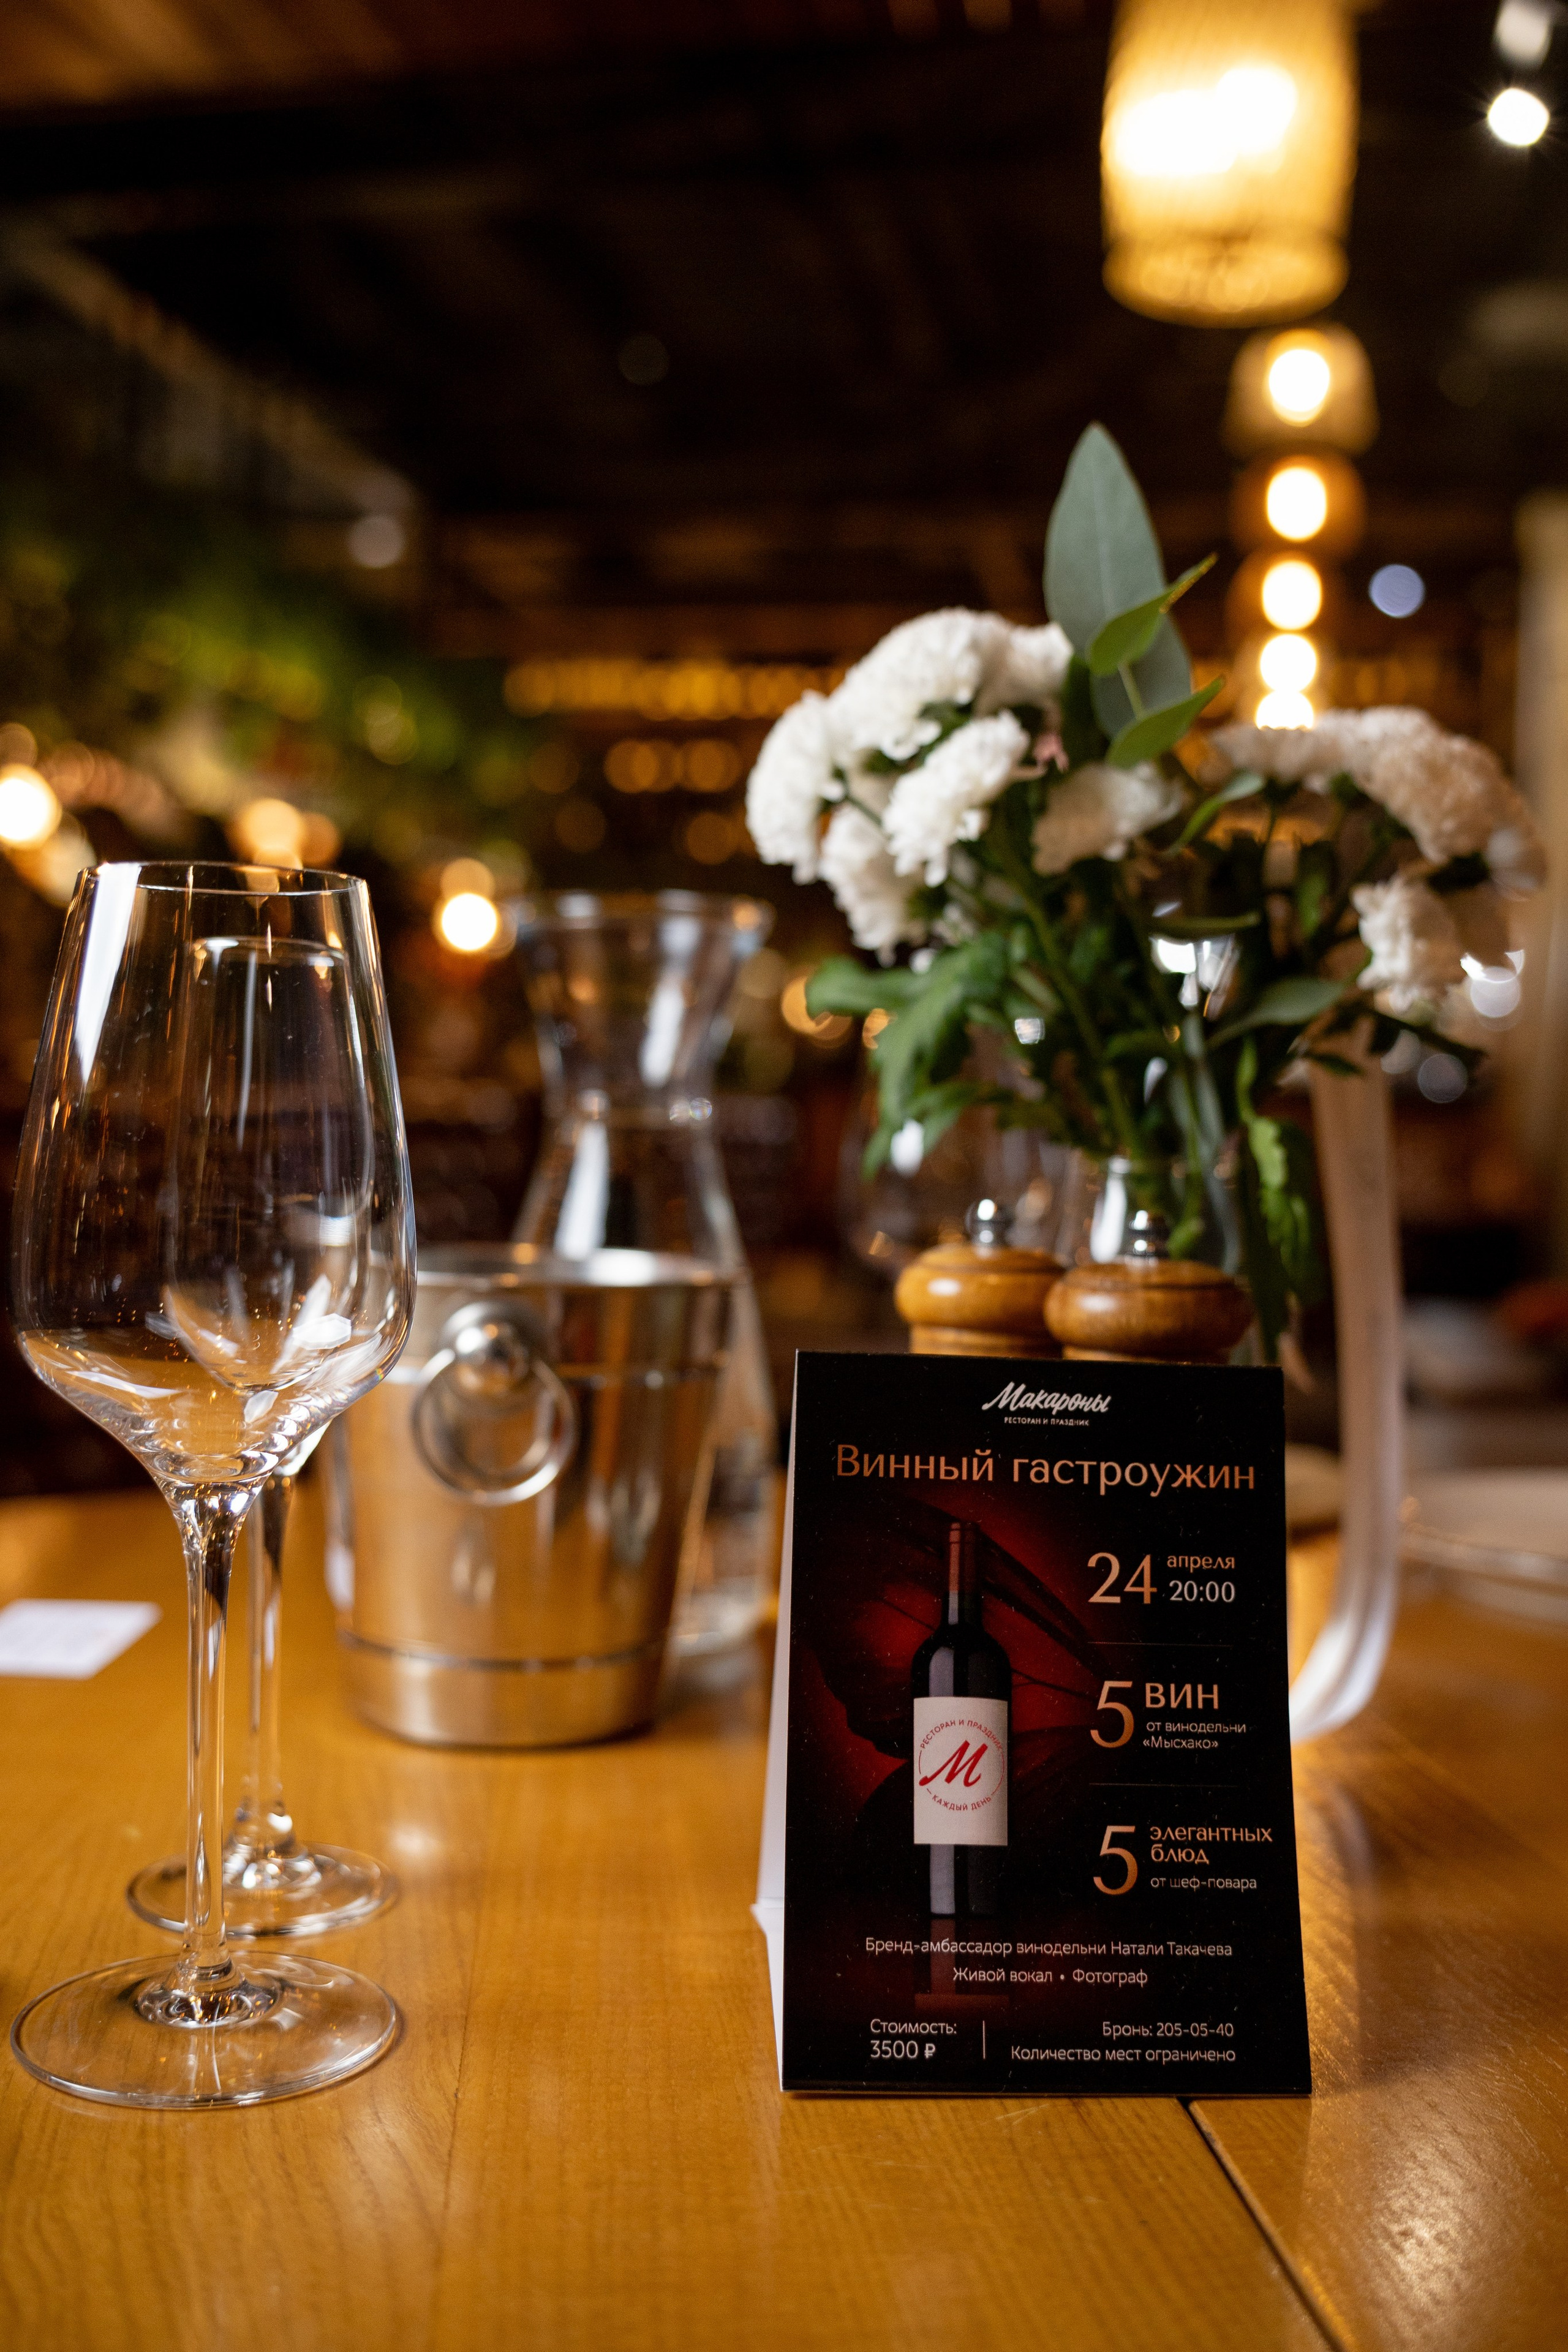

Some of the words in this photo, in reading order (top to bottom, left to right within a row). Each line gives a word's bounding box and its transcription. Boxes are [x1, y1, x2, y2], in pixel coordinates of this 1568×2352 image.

[982, 1381, 1112, 1415] Макароны
[1050, 1418, 1090, 1427] ПРАЗДНИК
[836, 1444, 994, 1482] Винный
[1013, 1457, 1255, 1497] гастроужин
[1087, 1551, 1157, 1604] 24
[1167, 1555, 1235, 1573] апреля
[1169, 1580, 1235, 1603] 20:00
[1090, 1681, 1134, 1748] 5
[921, 1721, 956, 1749] РЕСТОРАН
[967, 1721, 1003, 1750] ПРАЗДНИК
[1146, 1722, 1163, 1732] от
[1166, 1722, 1246, 1735] винодельни
[1143, 1736, 1218, 1750] «Мысхако»
[932, 1795, 968, 1811] КАЖДЫЙ
[971, 1796, 991, 1811] ДЕНЬ
[1093, 1825, 1138, 1896] 5
[1150, 1826, 1272, 1843] элегантных
[1151, 1844, 1209, 1865] блюд
[1150, 1877, 1166, 1888] от
[1169, 1875, 1257, 1891] шеф-повара
[865, 1937, 1012, 1956] Бренд-амбассадор
[1016, 1942, 1106, 1956] винодельни
[1111, 1942, 1164, 1955] Натали
[1167, 1942, 1232, 1956] Такачева
[952, 1967, 1006, 1983] Живой
[1011, 1969, 1052, 1983] вокал
[1072, 1969, 1148, 1986] Фотограф
[870, 2019, 957, 2035] Стоимость:
[1102, 2022, 1153, 2038] Бронь:
[1156, 2023, 1234, 2037] 205-05-40
[870, 2040, 919, 2058] 3500
[1011, 2046, 1100, 2062] Количество
[1105, 2048, 1142, 2060] мест
[1145, 2048, 1235, 2063] ограничено
